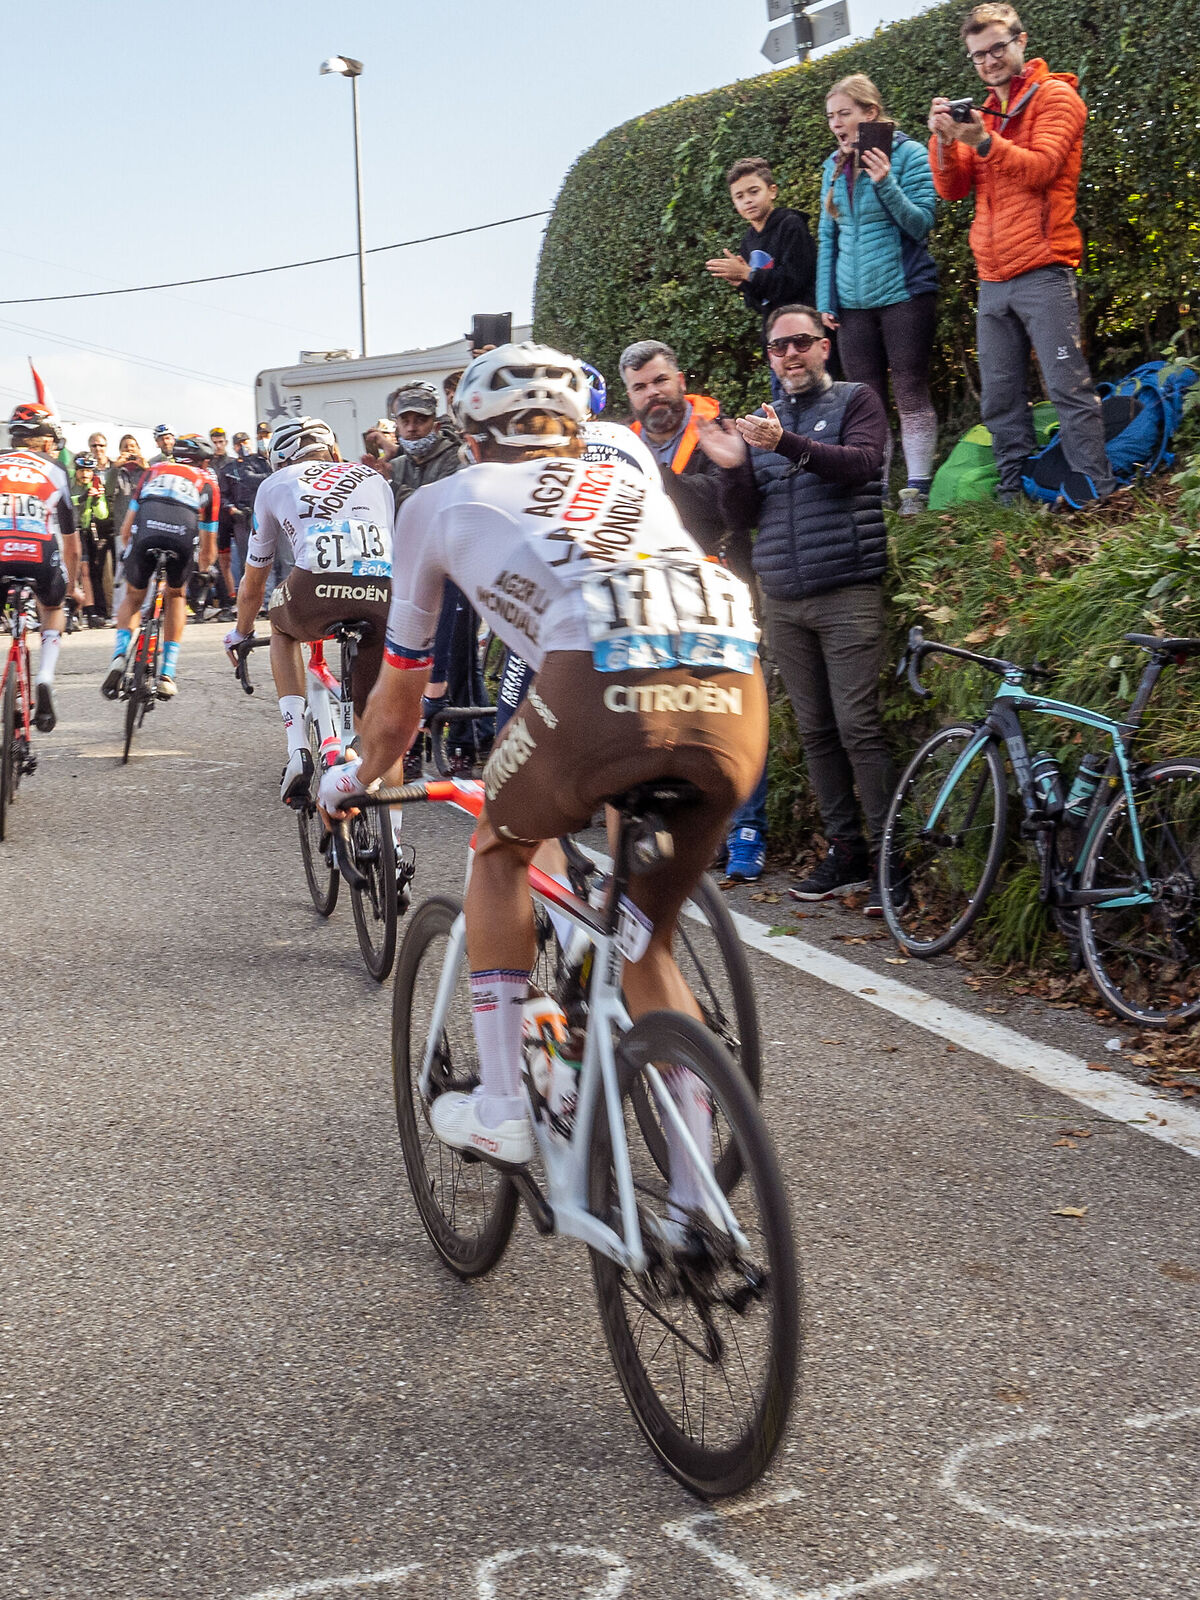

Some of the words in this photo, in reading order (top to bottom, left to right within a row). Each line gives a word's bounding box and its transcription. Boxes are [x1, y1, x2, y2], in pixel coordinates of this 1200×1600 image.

[299, 494, 321, 519] LA
[522, 461, 578, 518] AG2R
[357, 524, 385, 558] 13
[315, 584, 388, 602] CITROËN
[604, 680, 743, 715] CITROËN
